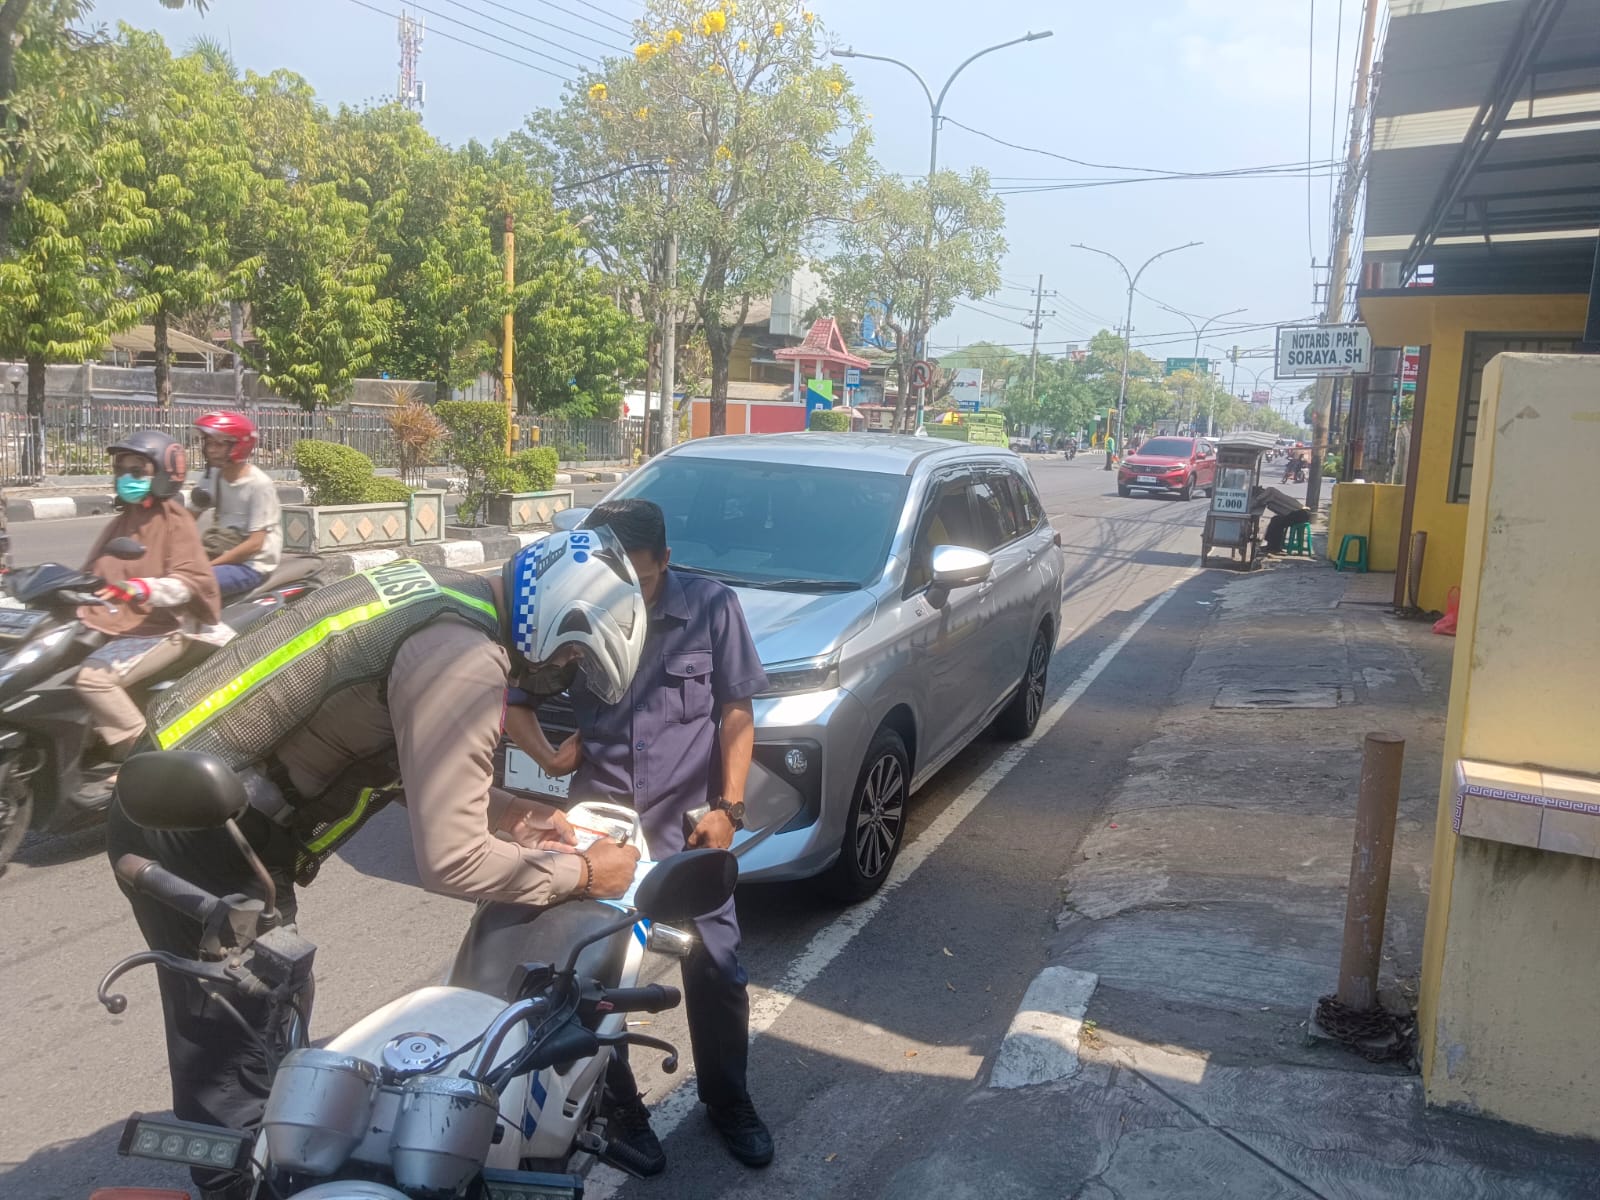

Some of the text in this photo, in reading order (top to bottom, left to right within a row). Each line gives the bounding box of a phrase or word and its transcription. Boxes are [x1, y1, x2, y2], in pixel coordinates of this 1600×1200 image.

[1292, 331, 1330, 349] NOTARIS
[1336, 331, 1359, 348] PPAT
[1217, 498, 1242, 509] 7.000
[509, 751, 519, 774] L
